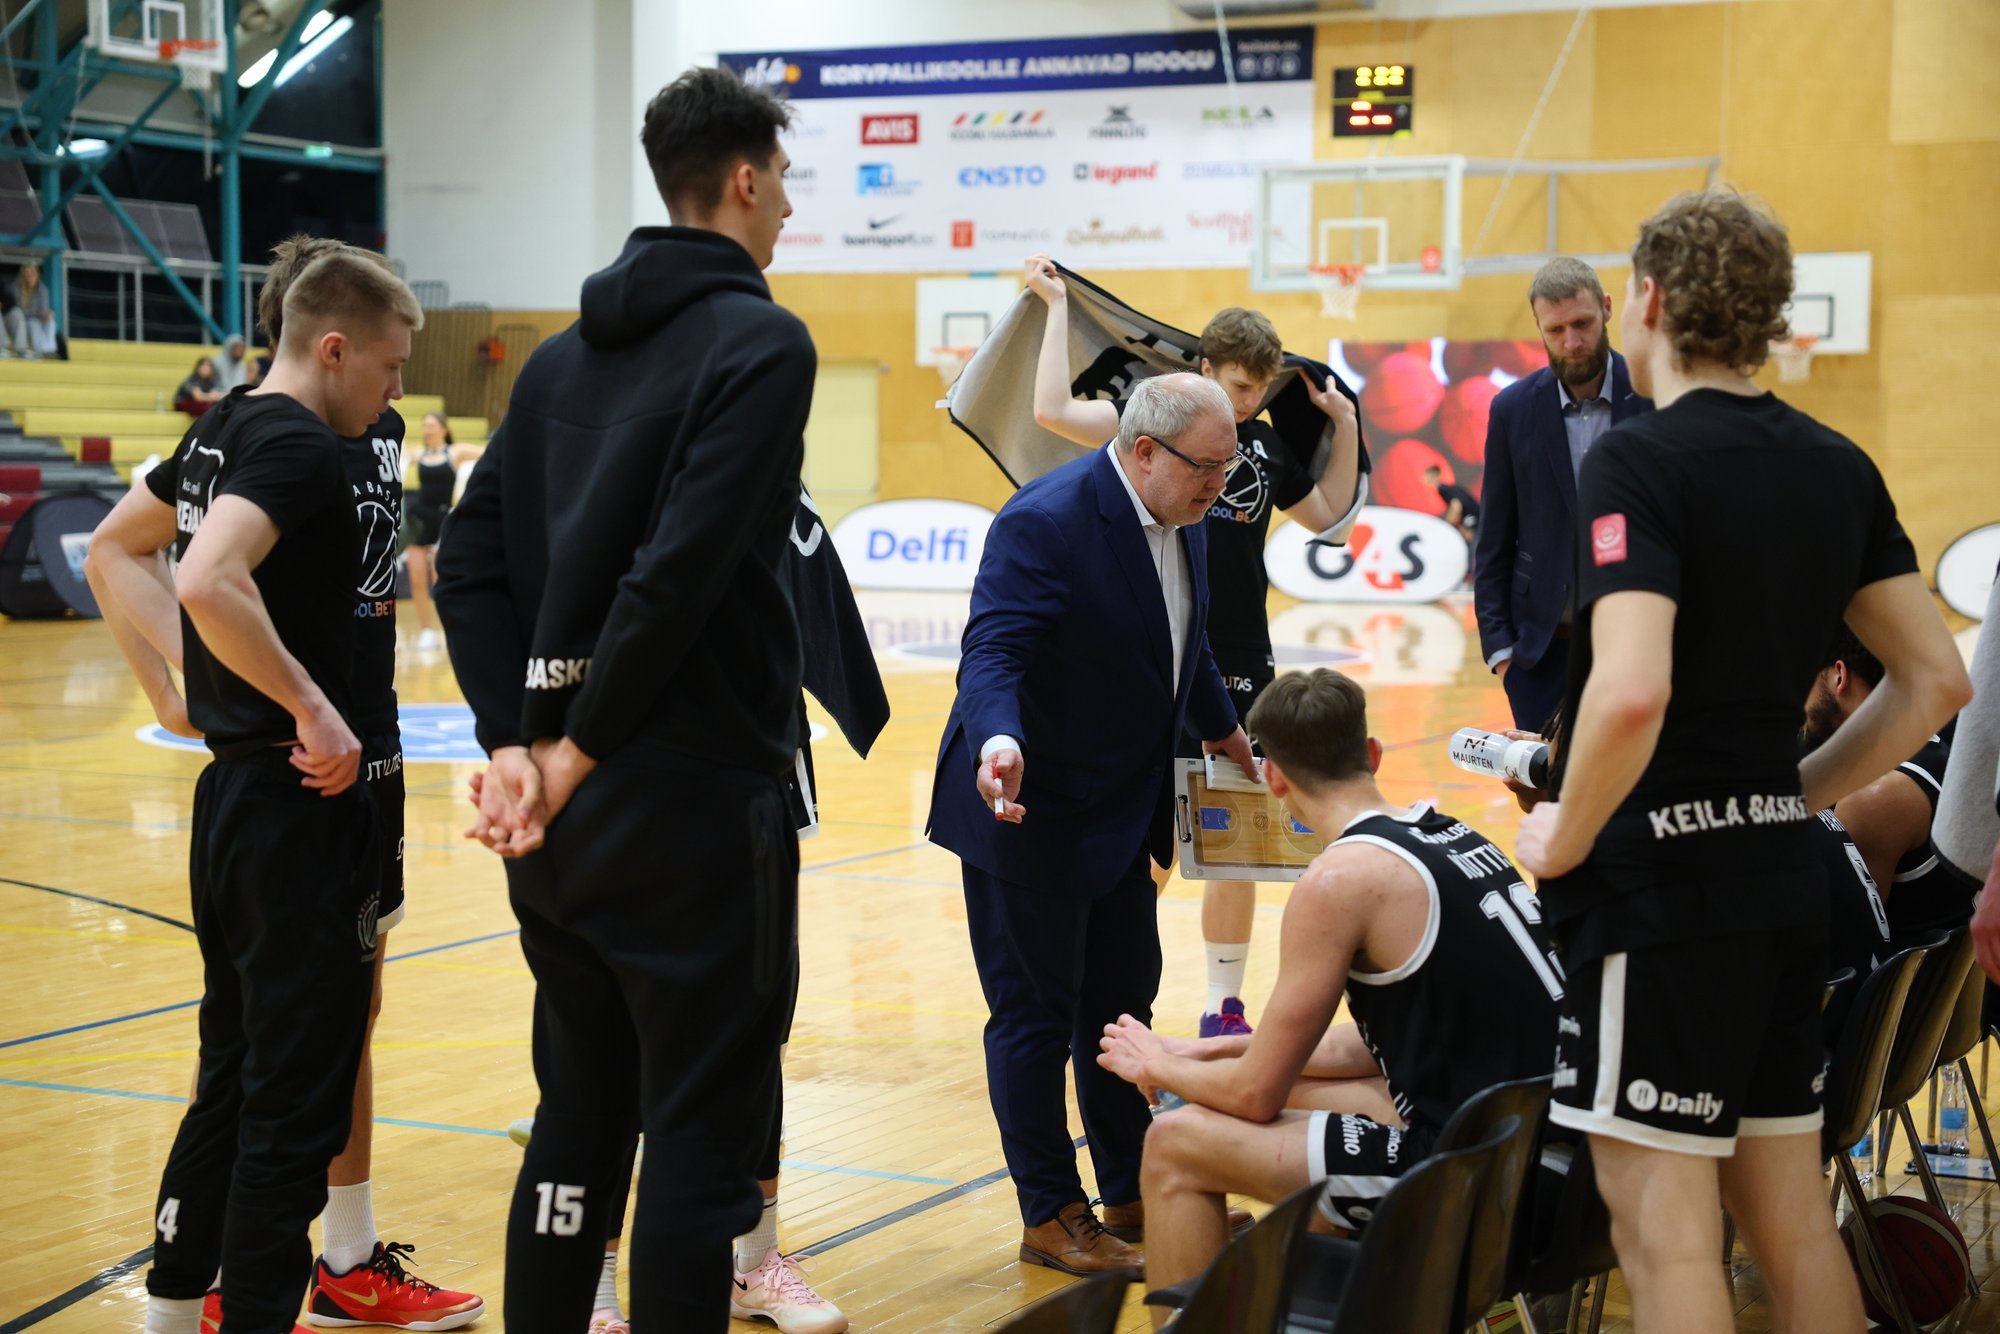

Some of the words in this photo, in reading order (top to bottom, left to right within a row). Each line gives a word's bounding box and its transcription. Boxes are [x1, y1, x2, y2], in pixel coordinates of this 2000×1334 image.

[820, 58, 1020, 86] KORVPALLIKOOLILE
[1023, 54, 1130, 76] ANNAVAD
[864, 119, 916, 140] AVIS
[958, 166, 1046, 187] ENSTO
[371, 438, 402, 482] 30
[867, 528, 968, 561] Delfi
[1453, 751, 1494, 770] MAURTEN
[1648, 796, 1745, 840] KEILA
[1658, 1091, 1724, 1124] Daily
[156, 1196, 181, 1244] 4
[535, 1181, 586, 1236] 15
